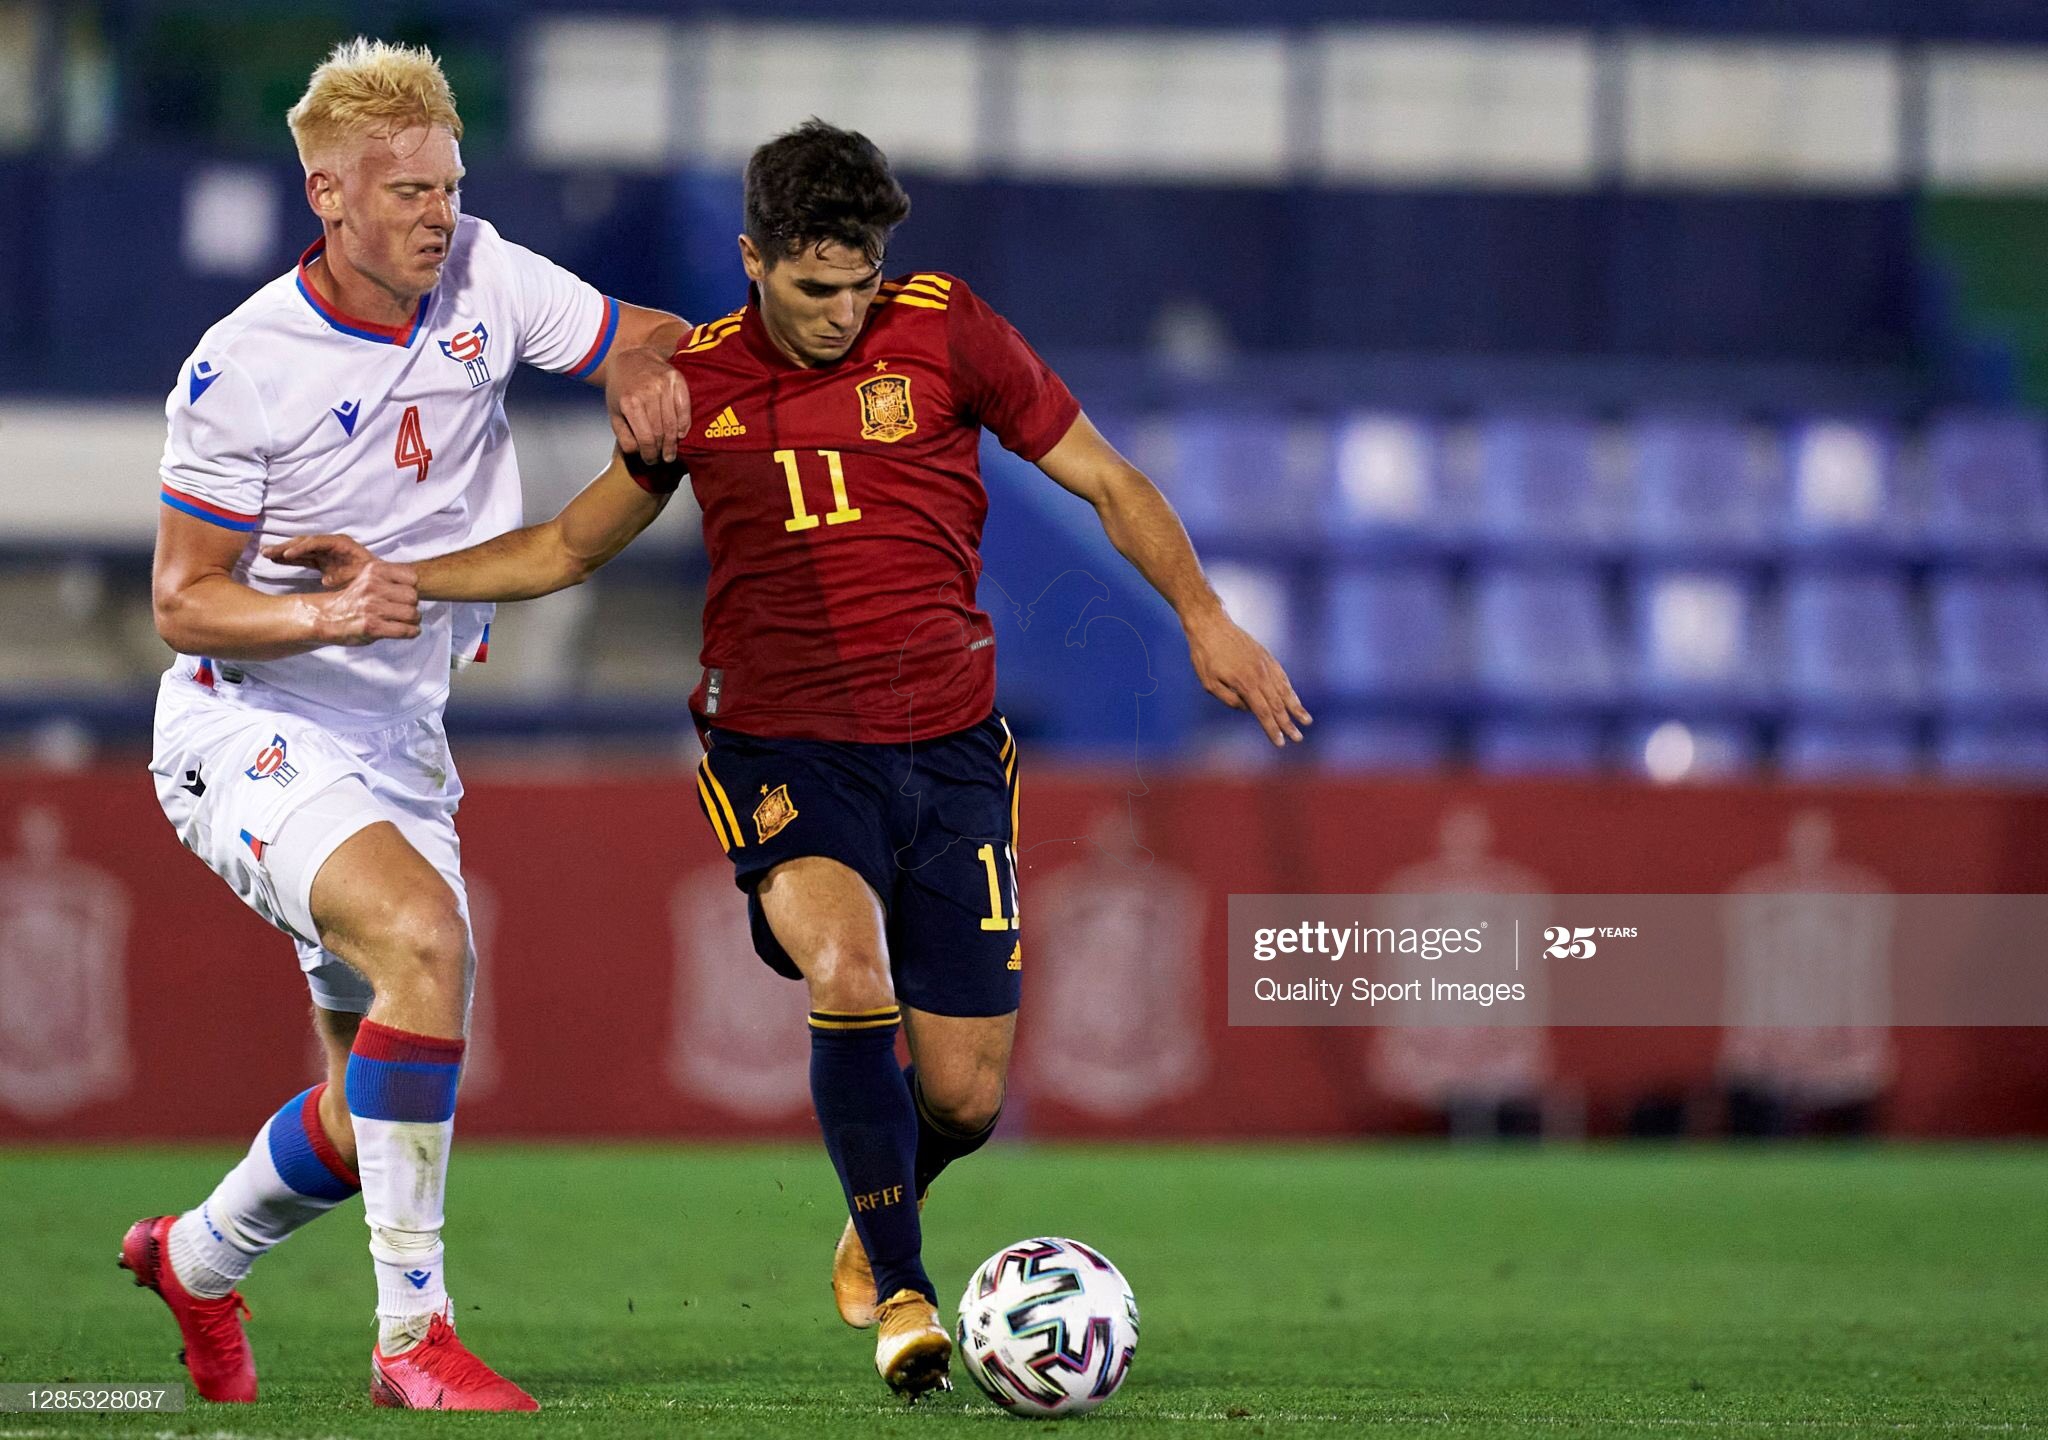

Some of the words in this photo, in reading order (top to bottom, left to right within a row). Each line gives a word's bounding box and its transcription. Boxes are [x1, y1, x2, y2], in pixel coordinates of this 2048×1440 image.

[394, 405, 433, 484] 4
[705, 425, 746, 438] adidas
[773, 449, 862, 532] 11
[854, 1184, 903, 1212] RFEF
